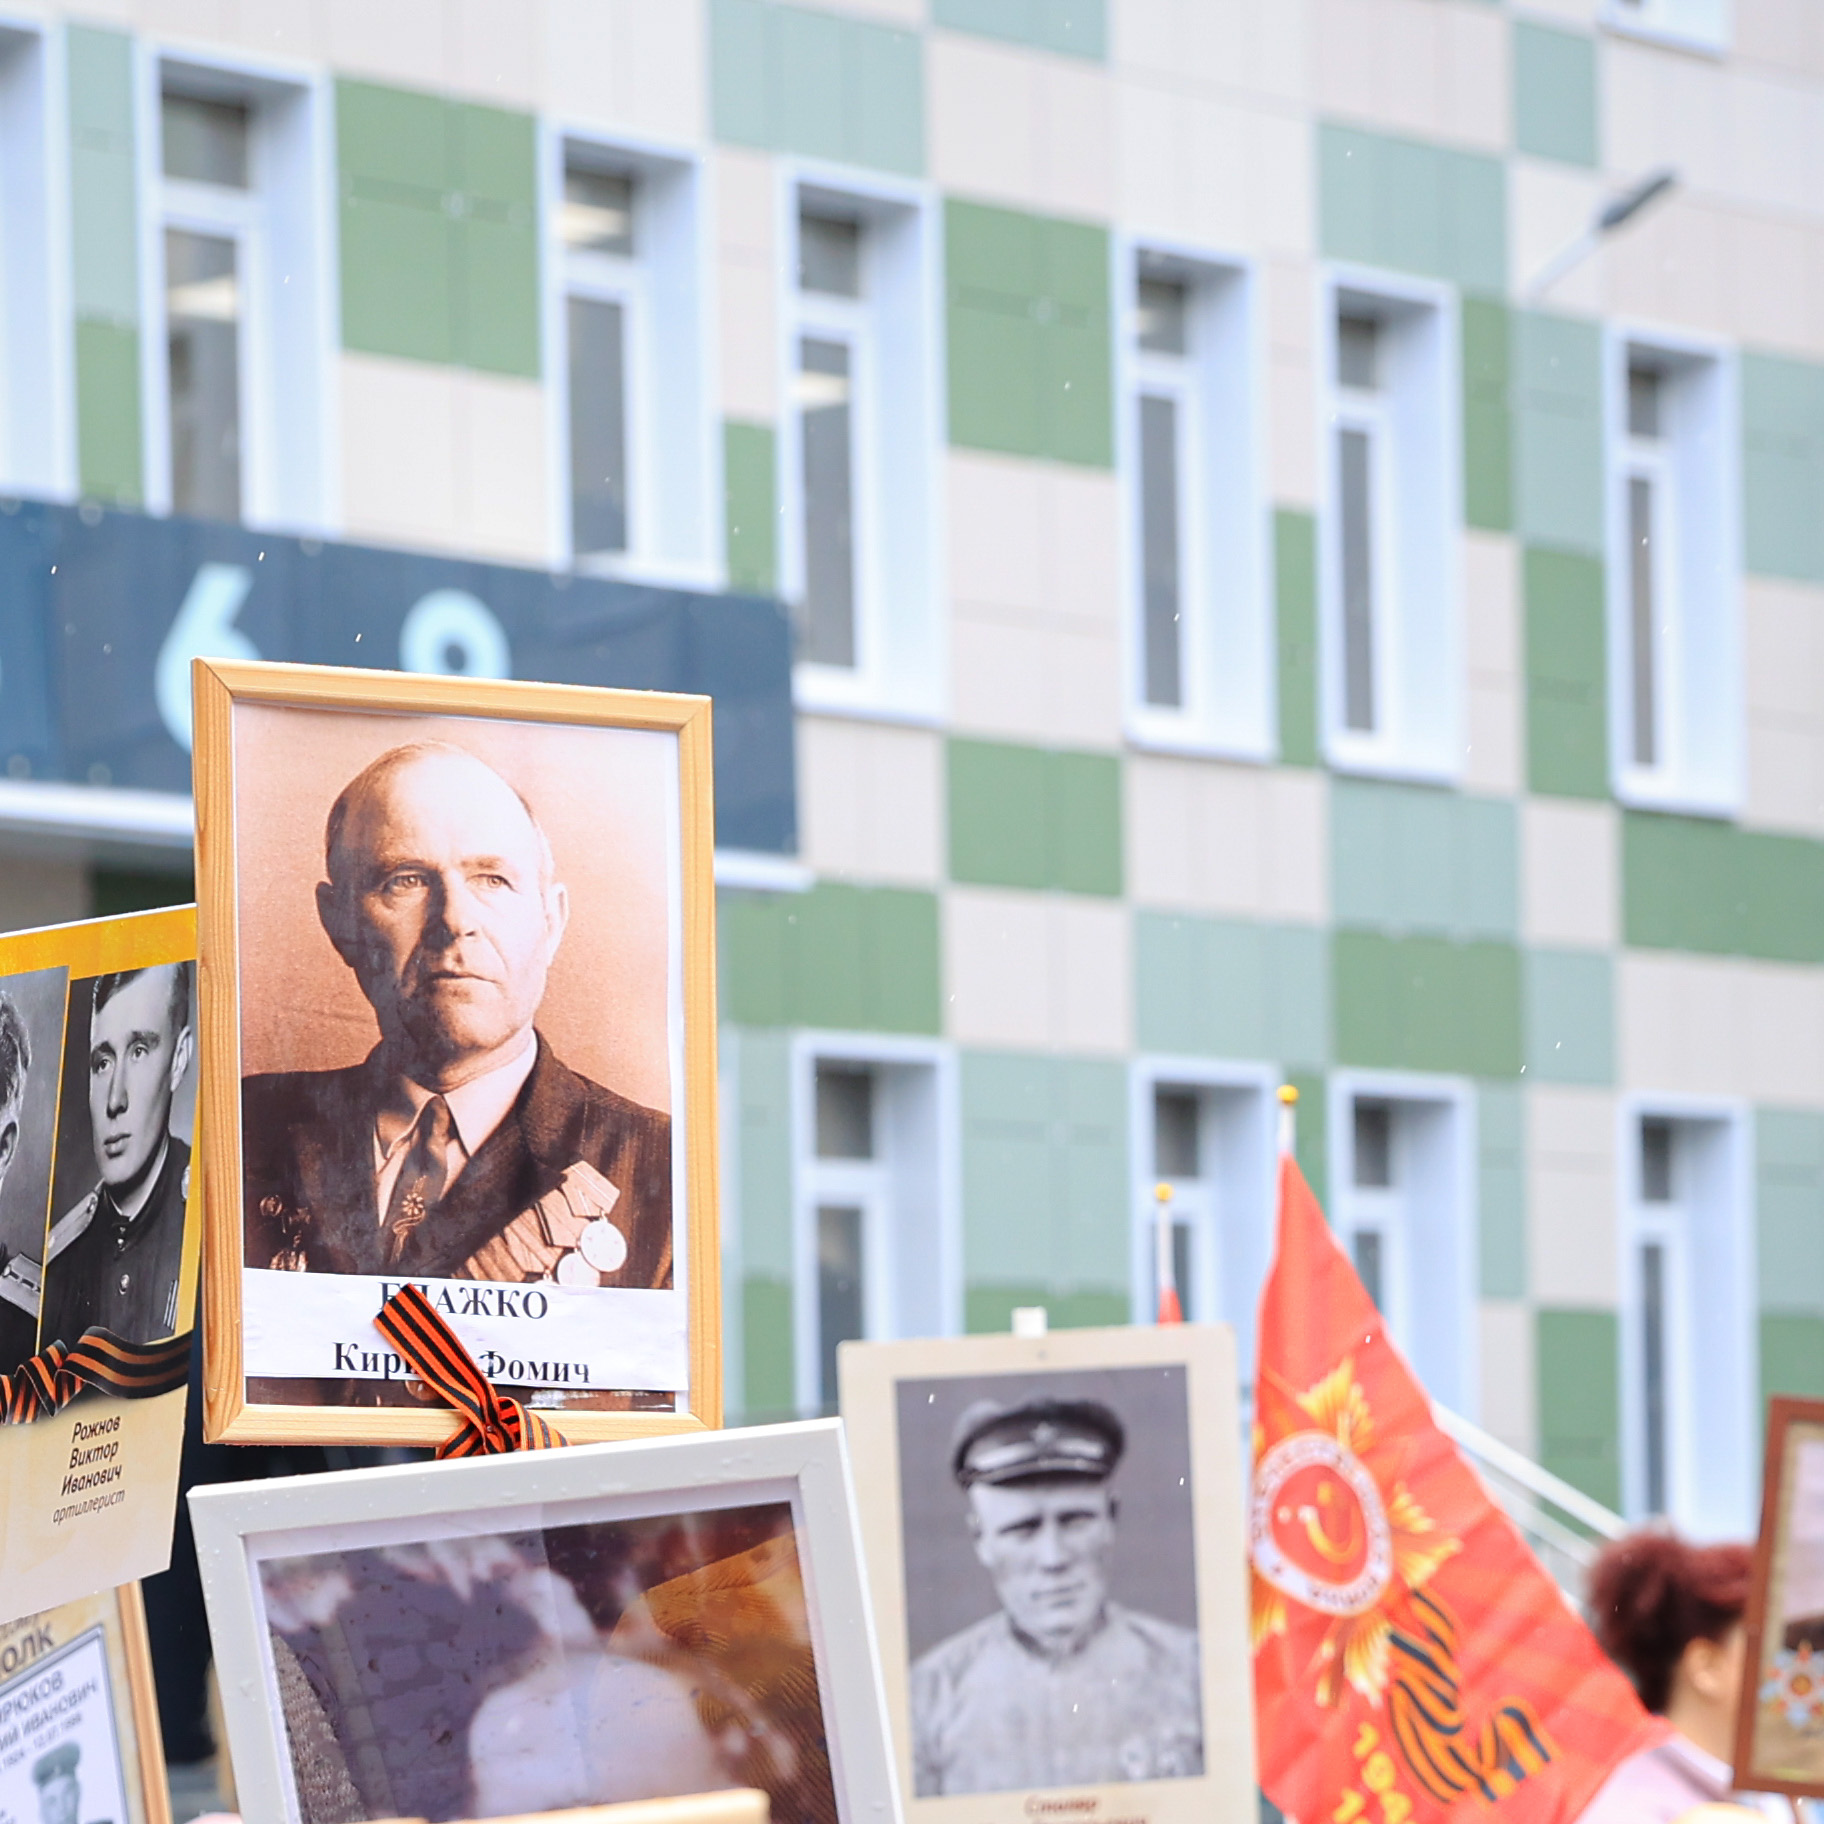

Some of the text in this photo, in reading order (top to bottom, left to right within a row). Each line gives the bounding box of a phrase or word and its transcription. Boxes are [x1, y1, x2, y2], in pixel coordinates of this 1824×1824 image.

[478, 1350, 590, 1383] Фомич
[72, 1416, 121, 1443] Рожнов
[69, 1441, 119, 1469] Виктор
[61, 1464, 122, 1496] Иванович
[52, 1489, 125, 1526] артиллерист
[22, 1676, 99, 1737] ИВАНОВИЧ
